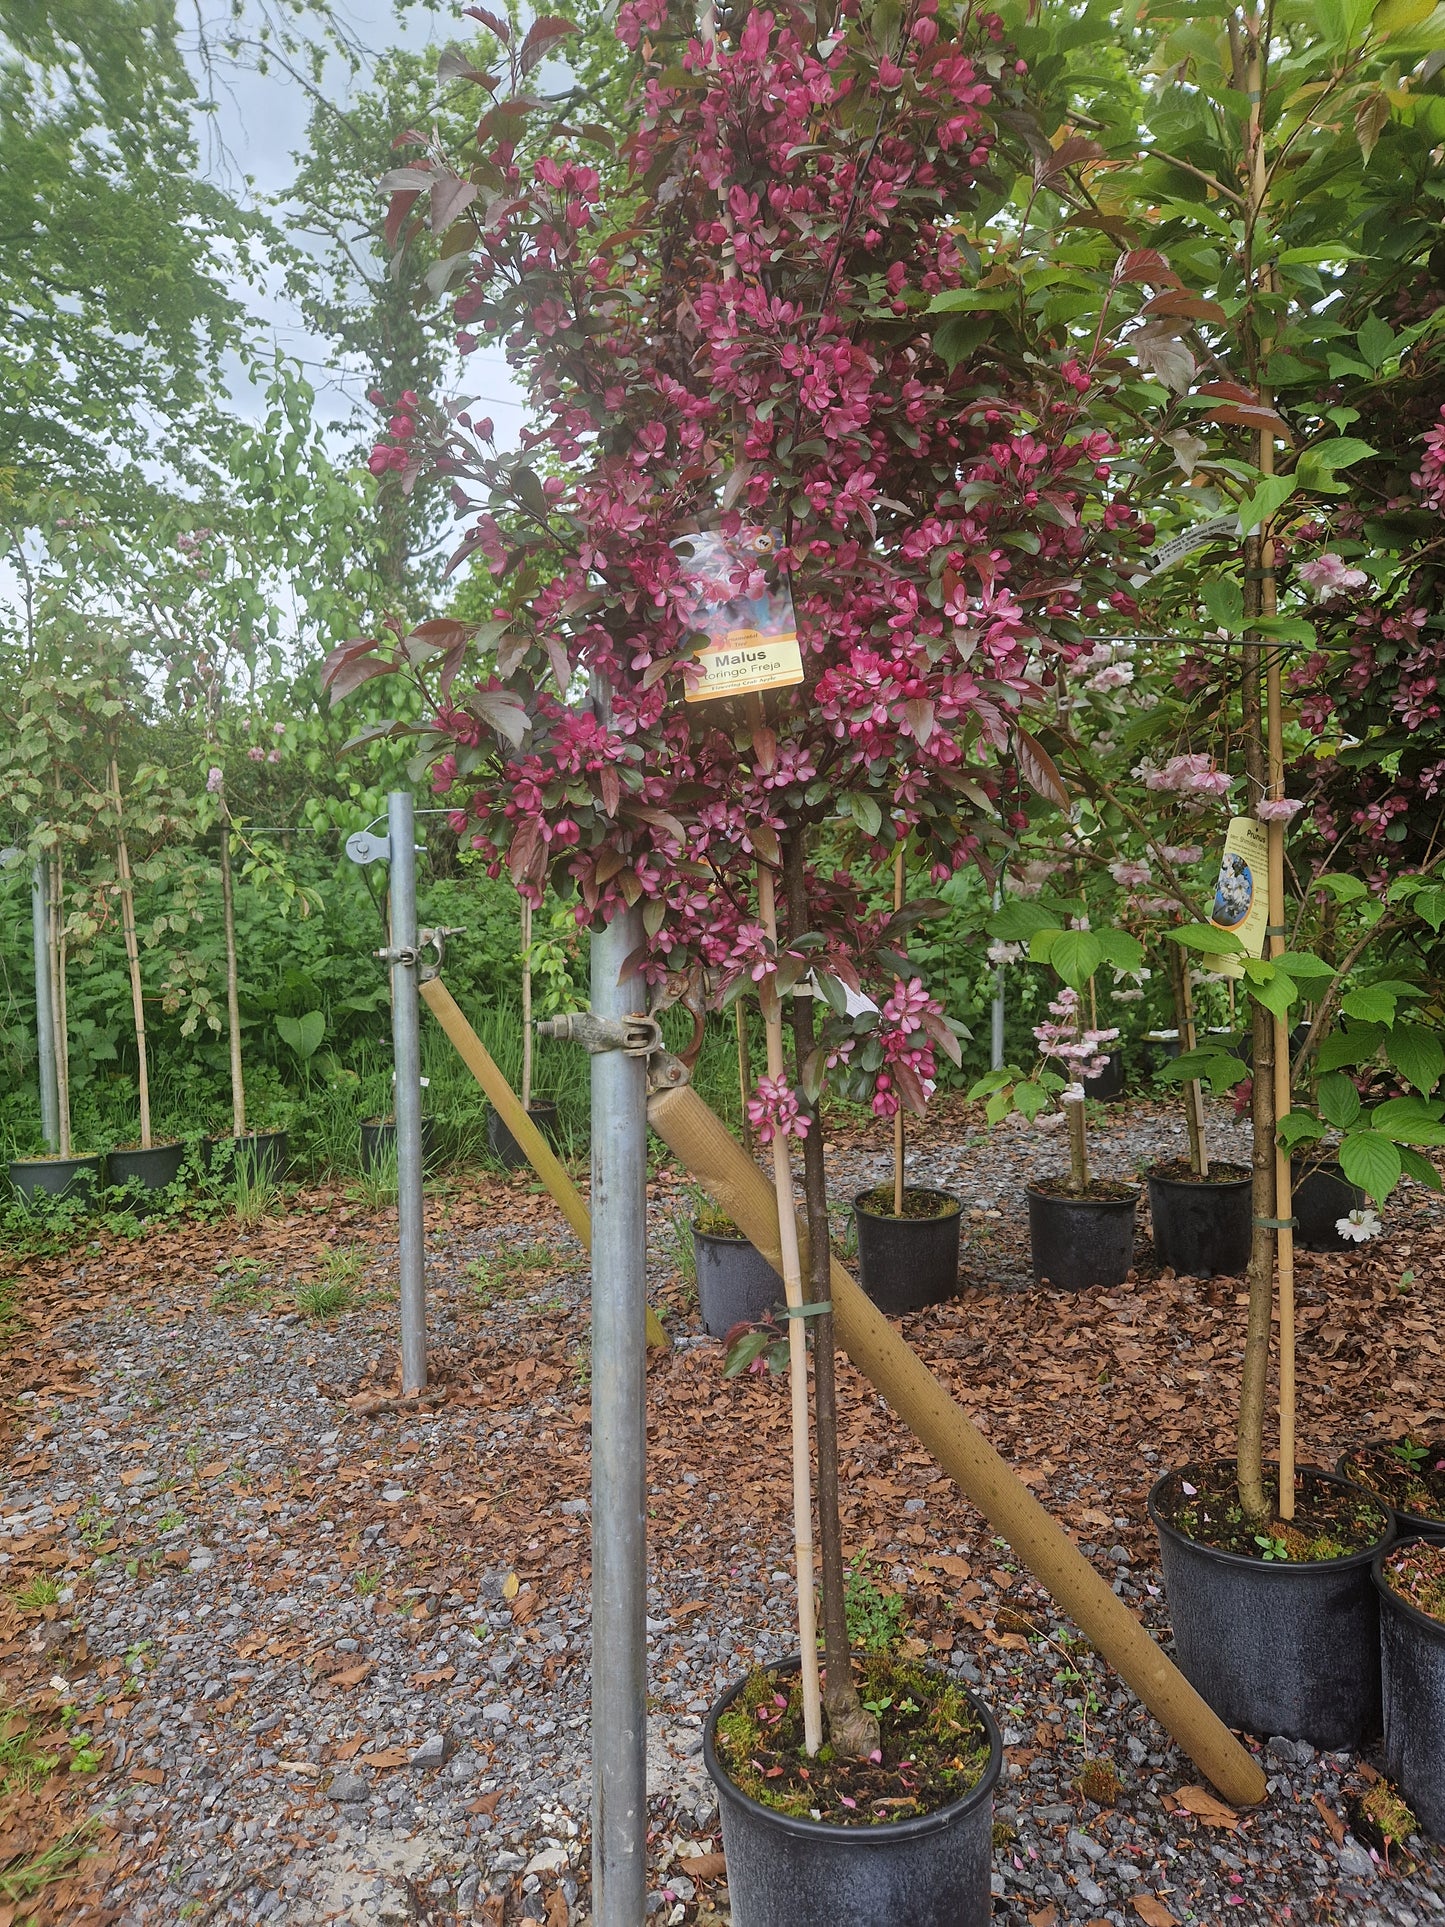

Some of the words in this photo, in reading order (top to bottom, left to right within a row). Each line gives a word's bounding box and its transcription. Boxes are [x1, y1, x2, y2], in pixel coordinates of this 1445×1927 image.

[715, 650, 767, 668] Malus
[704, 668, 747, 680] toringo
[750, 661, 781, 673] Freja
[711, 682, 741, 691] Flowering
[759, 675, 776, 683] Apple
[1246, 828, 1266, 844] Prunus
